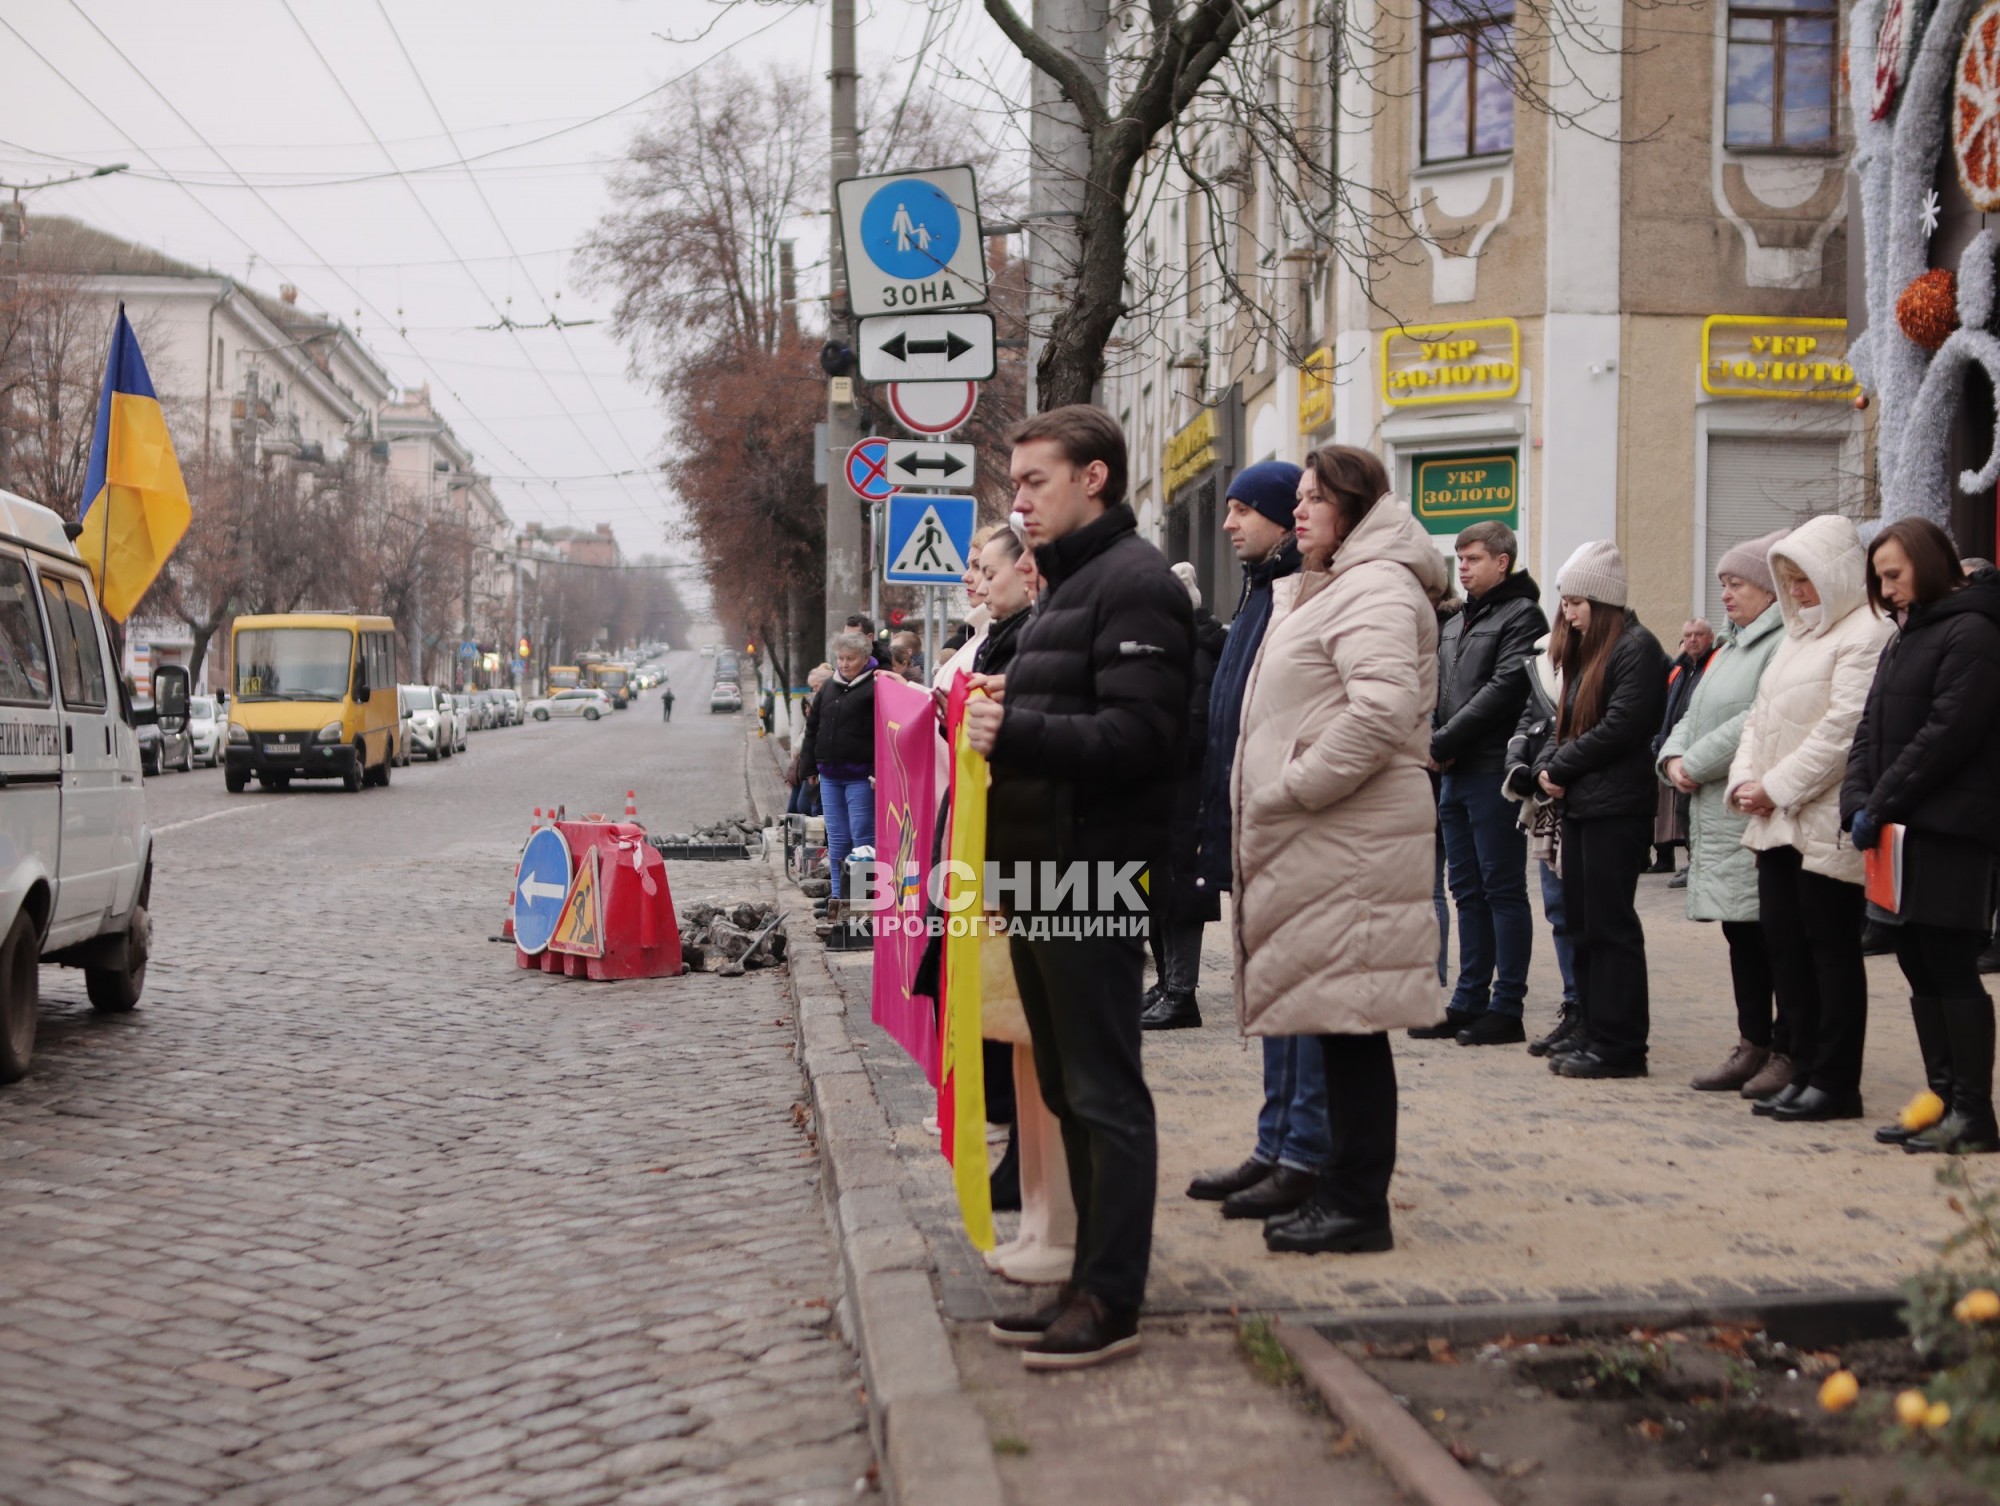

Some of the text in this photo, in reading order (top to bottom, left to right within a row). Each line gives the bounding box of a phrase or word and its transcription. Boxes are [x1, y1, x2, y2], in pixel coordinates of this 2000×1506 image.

[882, 280, 956, 307] ЗОНА
[1420, 339, 1478, 361] УКР
[1751, 335, 1817, 356] УКР
[1388, 363, 1514, 389] ЗОЛОТО
[1710, 359, 1855, 382] ЗОЛОТО
[1447, 470, 1487, 485] УКР
[1424, 486, 1511, 505] ЗОЛОТО
